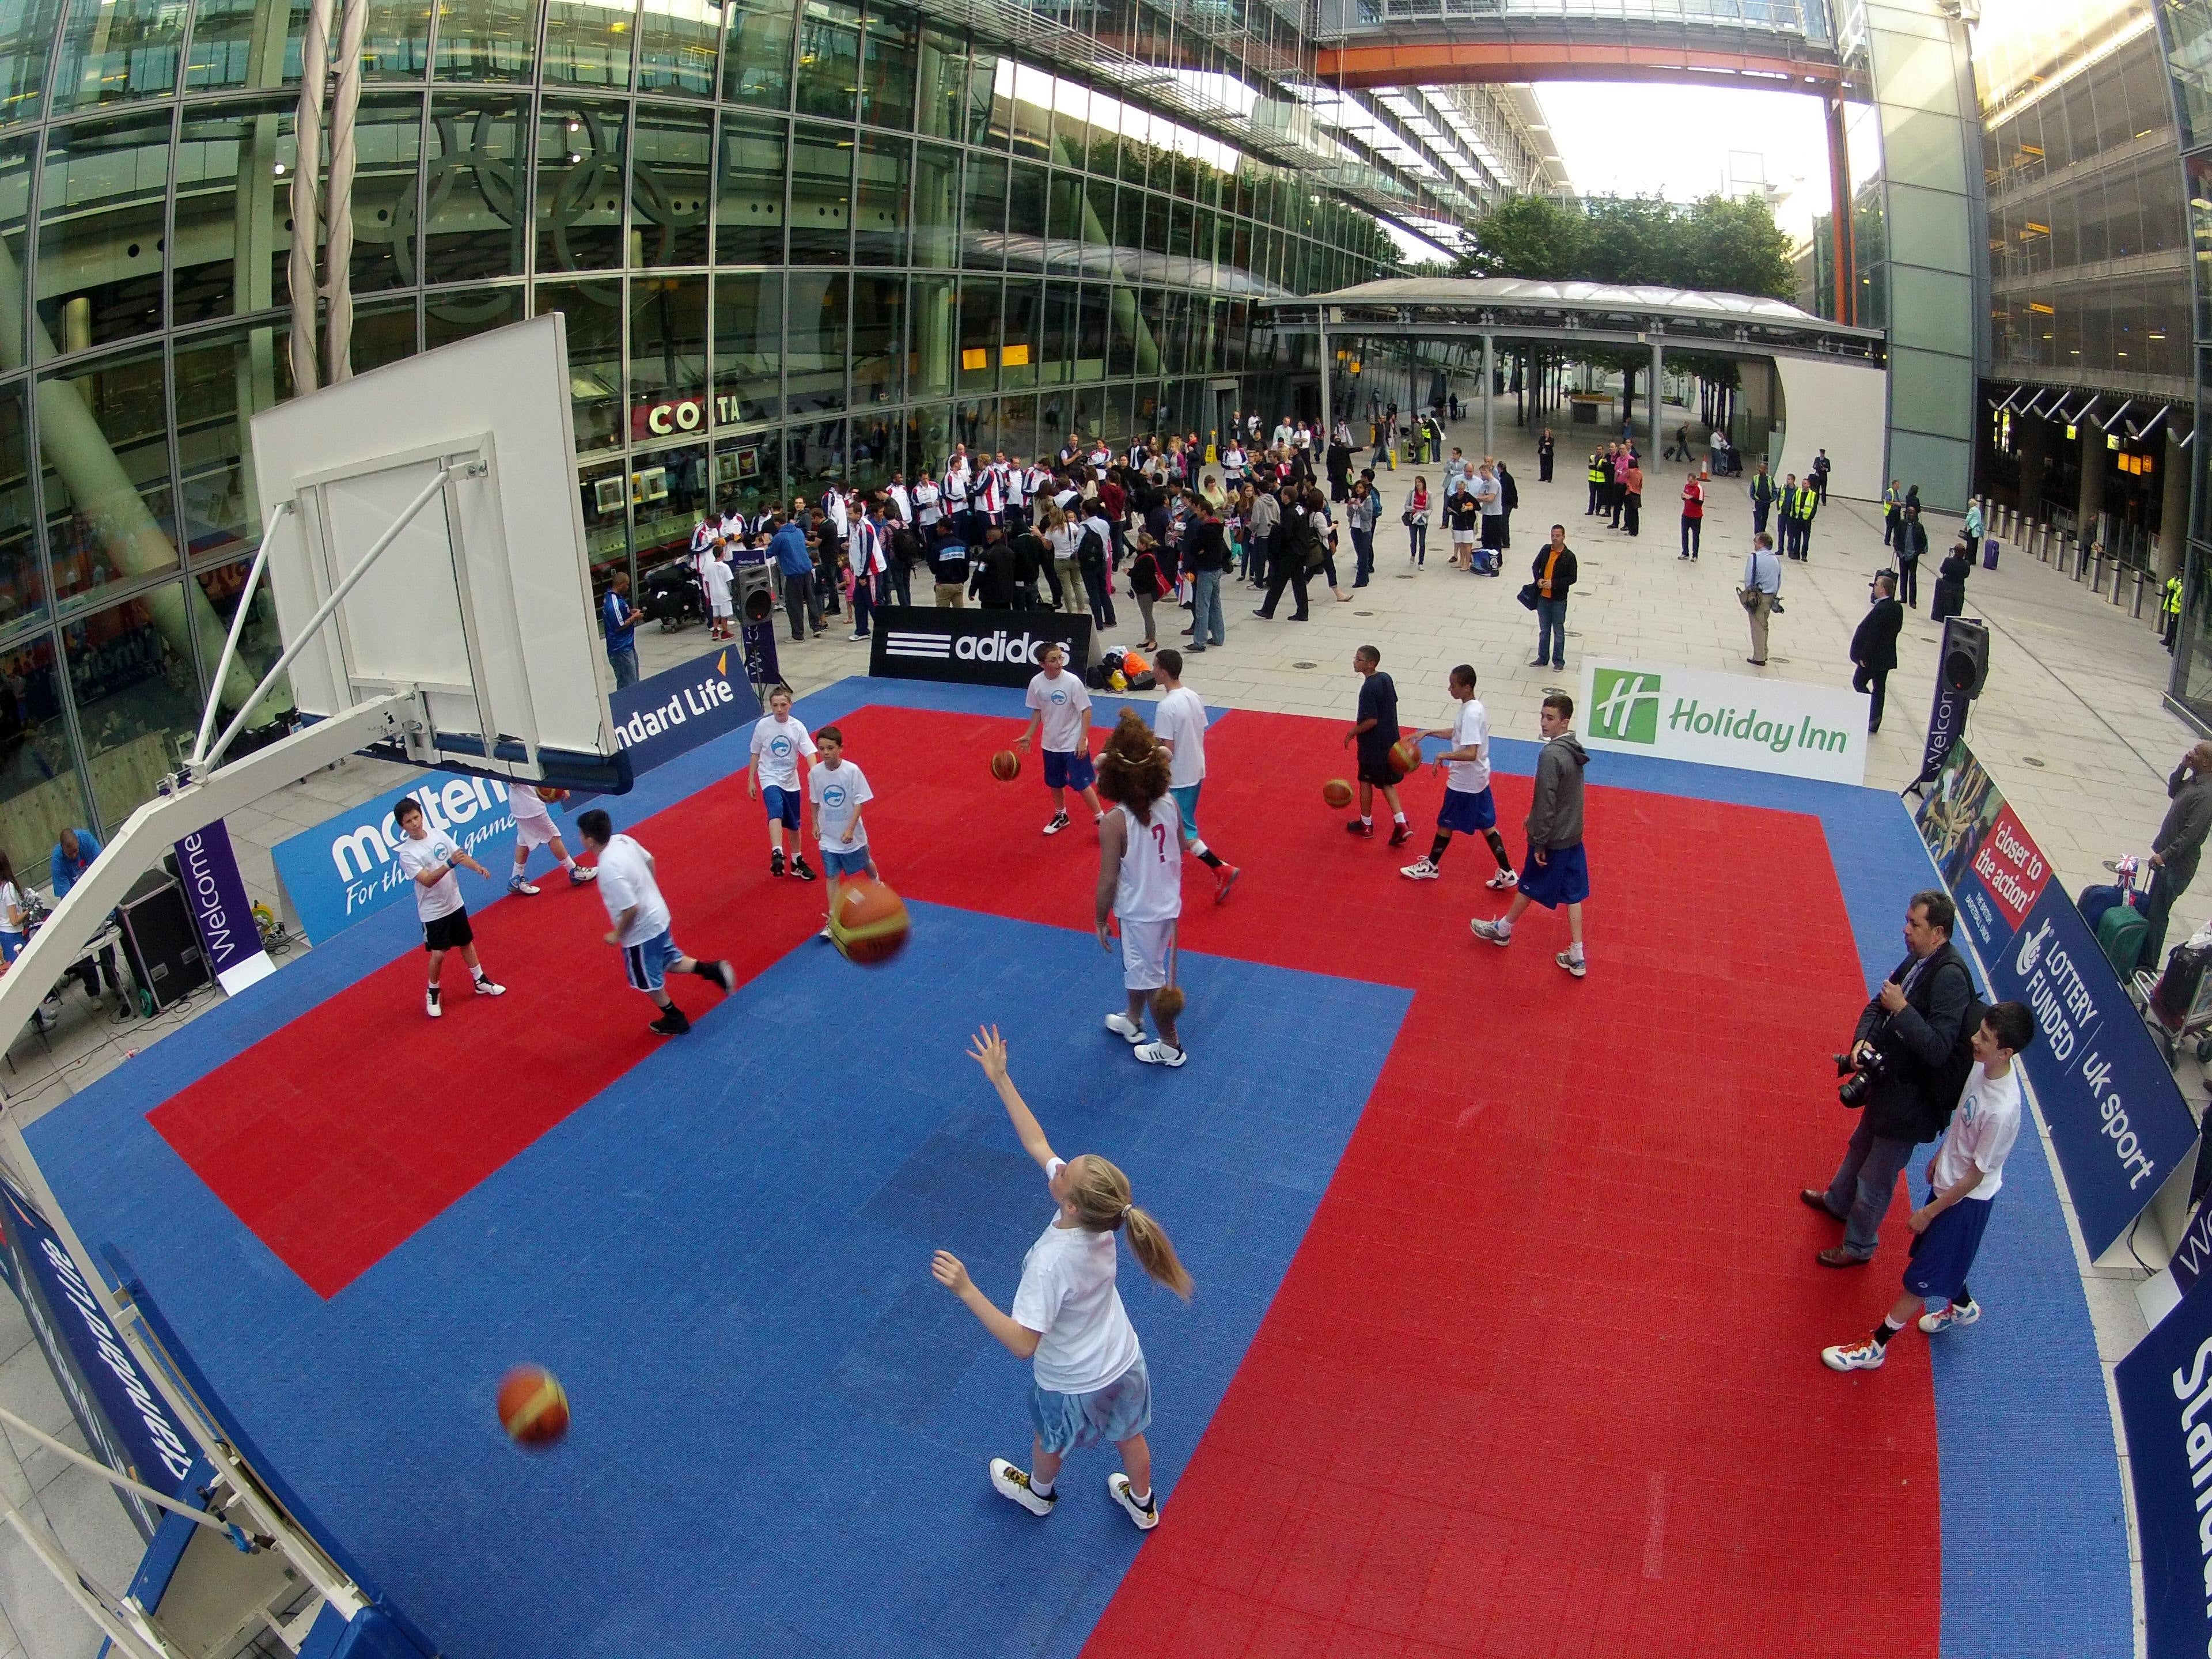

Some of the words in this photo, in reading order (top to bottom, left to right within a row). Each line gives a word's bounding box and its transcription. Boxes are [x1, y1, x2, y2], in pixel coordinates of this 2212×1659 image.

[649, 396, 741, 434] COTA
[684, 678, 734, 716] Life
[1669, 698, 1794, 753] Holiday
[1798, 715, 1848, 753] Inn
[464, 813, 517, 857] game
[1152, 824, 1165, 863] ?
[1975, 847, 1995, 880] the
[2027, 853, 2042, 880] to
[184, 833, 236, 963] Welcome
[346, 879, 378, 915] For
[2045, 941, 2098, 1028] LOTTERY
[2025, 968, 2074, 1061] FUNDED
[2082, 1051, 2112, 1099] uk
[2100, 1093, 2154, 1190] sport
[40, 1238, 97, 1310] Life
[66, 1292, 192, 1480] Standard
